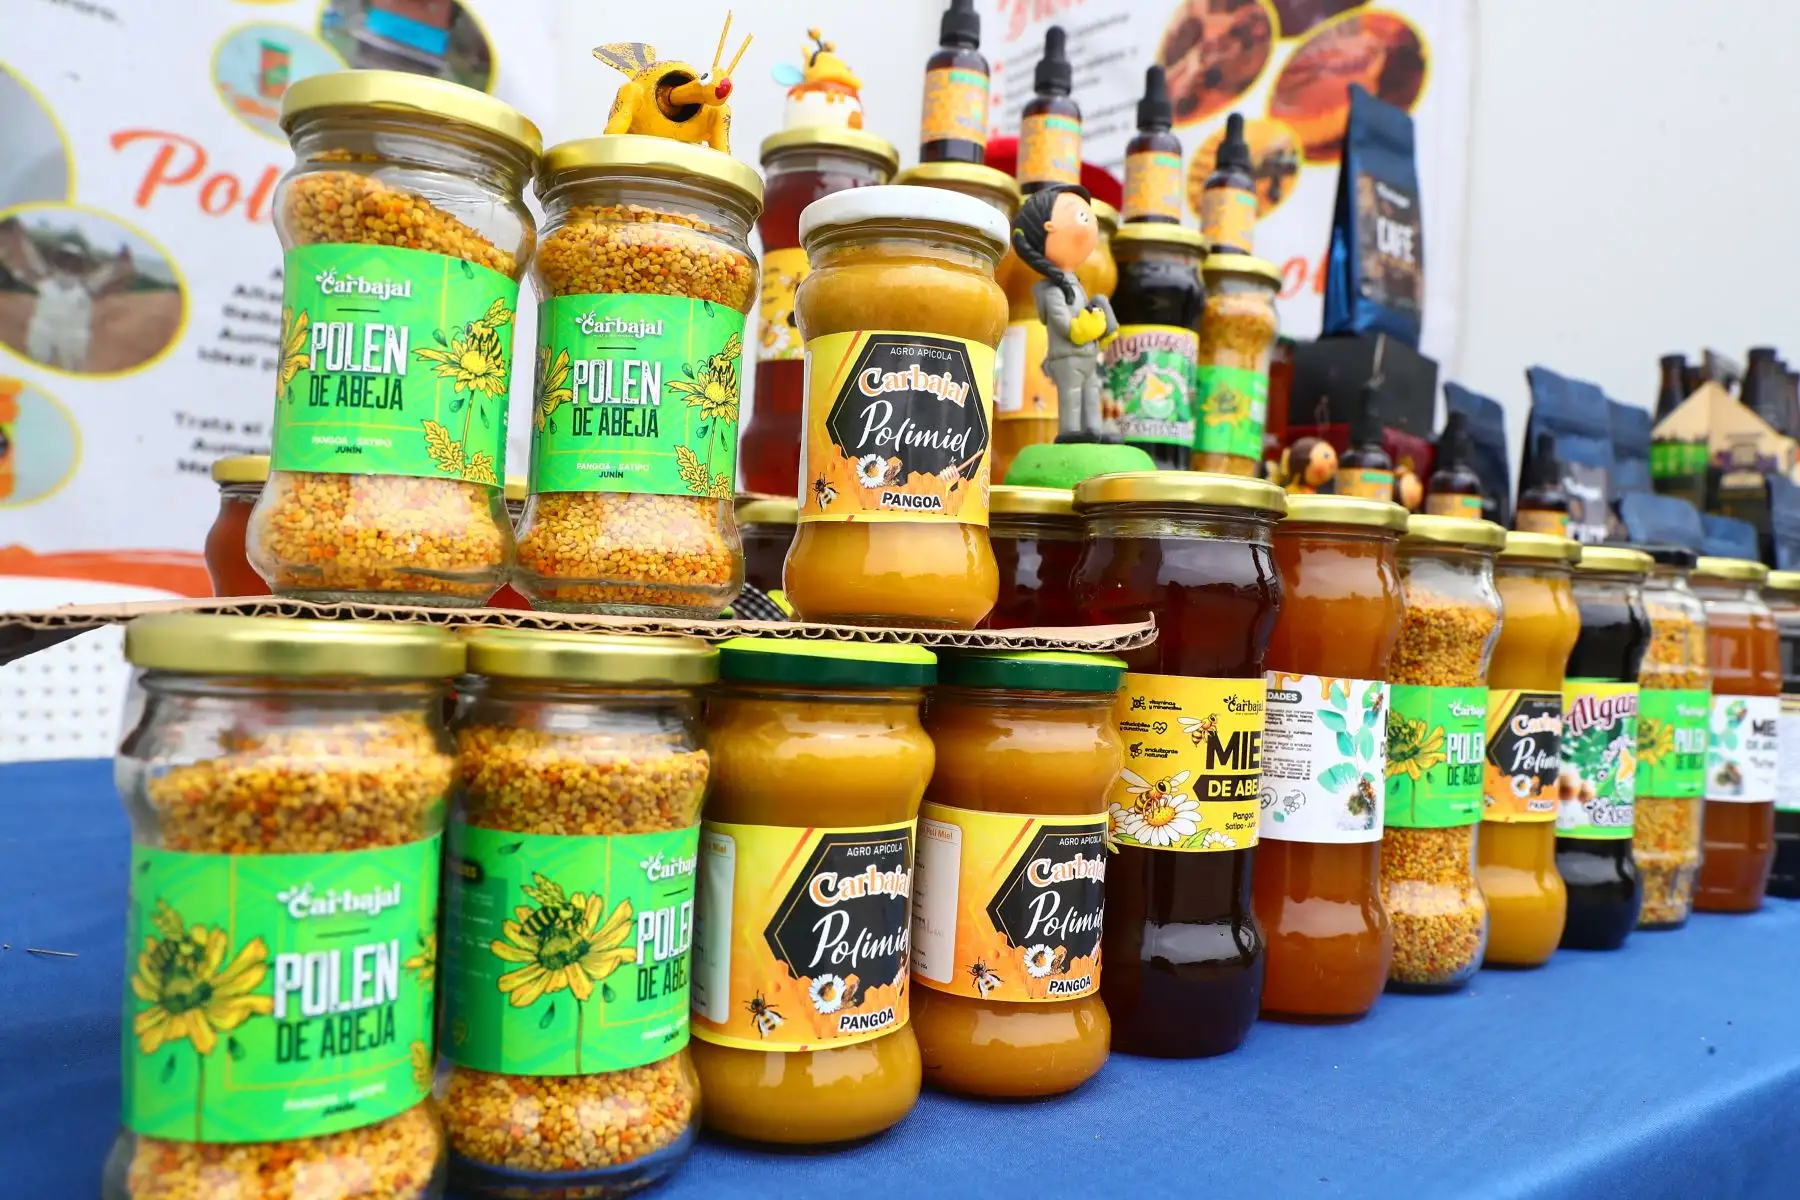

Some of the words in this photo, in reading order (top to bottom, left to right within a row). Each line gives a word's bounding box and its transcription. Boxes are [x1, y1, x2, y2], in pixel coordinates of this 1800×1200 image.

[317, 271, 411, 300] Carbajal
[577, 311, 663, 339] Carbajal
[310, 321, 409, 376] POLEN
[890, 347, 914, 356] AGRO
[917, 346, 952, 361] APÍCOLA
[308, 374, 331, 407] DE
[335, 374, 404, 411] ABEJA
[572, 359, 661, 406] POLEN
[858, 364, 969, 408] Carbajal
[572, 407, 593, 436] DE
[597, 407, 659, 438] ABEJA
[856, 400, 972, 457] Polimiel
[576, 462, 611, 471] PANGOA
[598, 469, 624, 479] JUNÍN
[881, 491, 942, 509] PANGOA
[1224, 695, 1264, 715] Carbajal
[1267, 692, 1298, 702] DADES
[1205, 731, 1261, 771] MIE
[1208, 780, 1232, 797] DE
[1234, 779, 1260, 797] ABE
[1447, 766, 1460, 786] DE
[846, 845, 871, 857] AGRO
[873, 841, 903, 854] APÍCOLA
[1058, 838, 1079, 846] AGRO
[809, 864, 912, 908] Carbajal
[279, 883, 401, 918] Carbajal
[273, 938, 400, 1019] POLEN
[637, 965, 659, 1002] DE
[662, 957, 688, 996] ABE
[1048, 974, 1092, 994] PANGOA
[276, 1018, 311, 1064] DE
[320, 1004, 396, 1060] ABEJA
[838, 1007, 895, 1033] PANGOA
